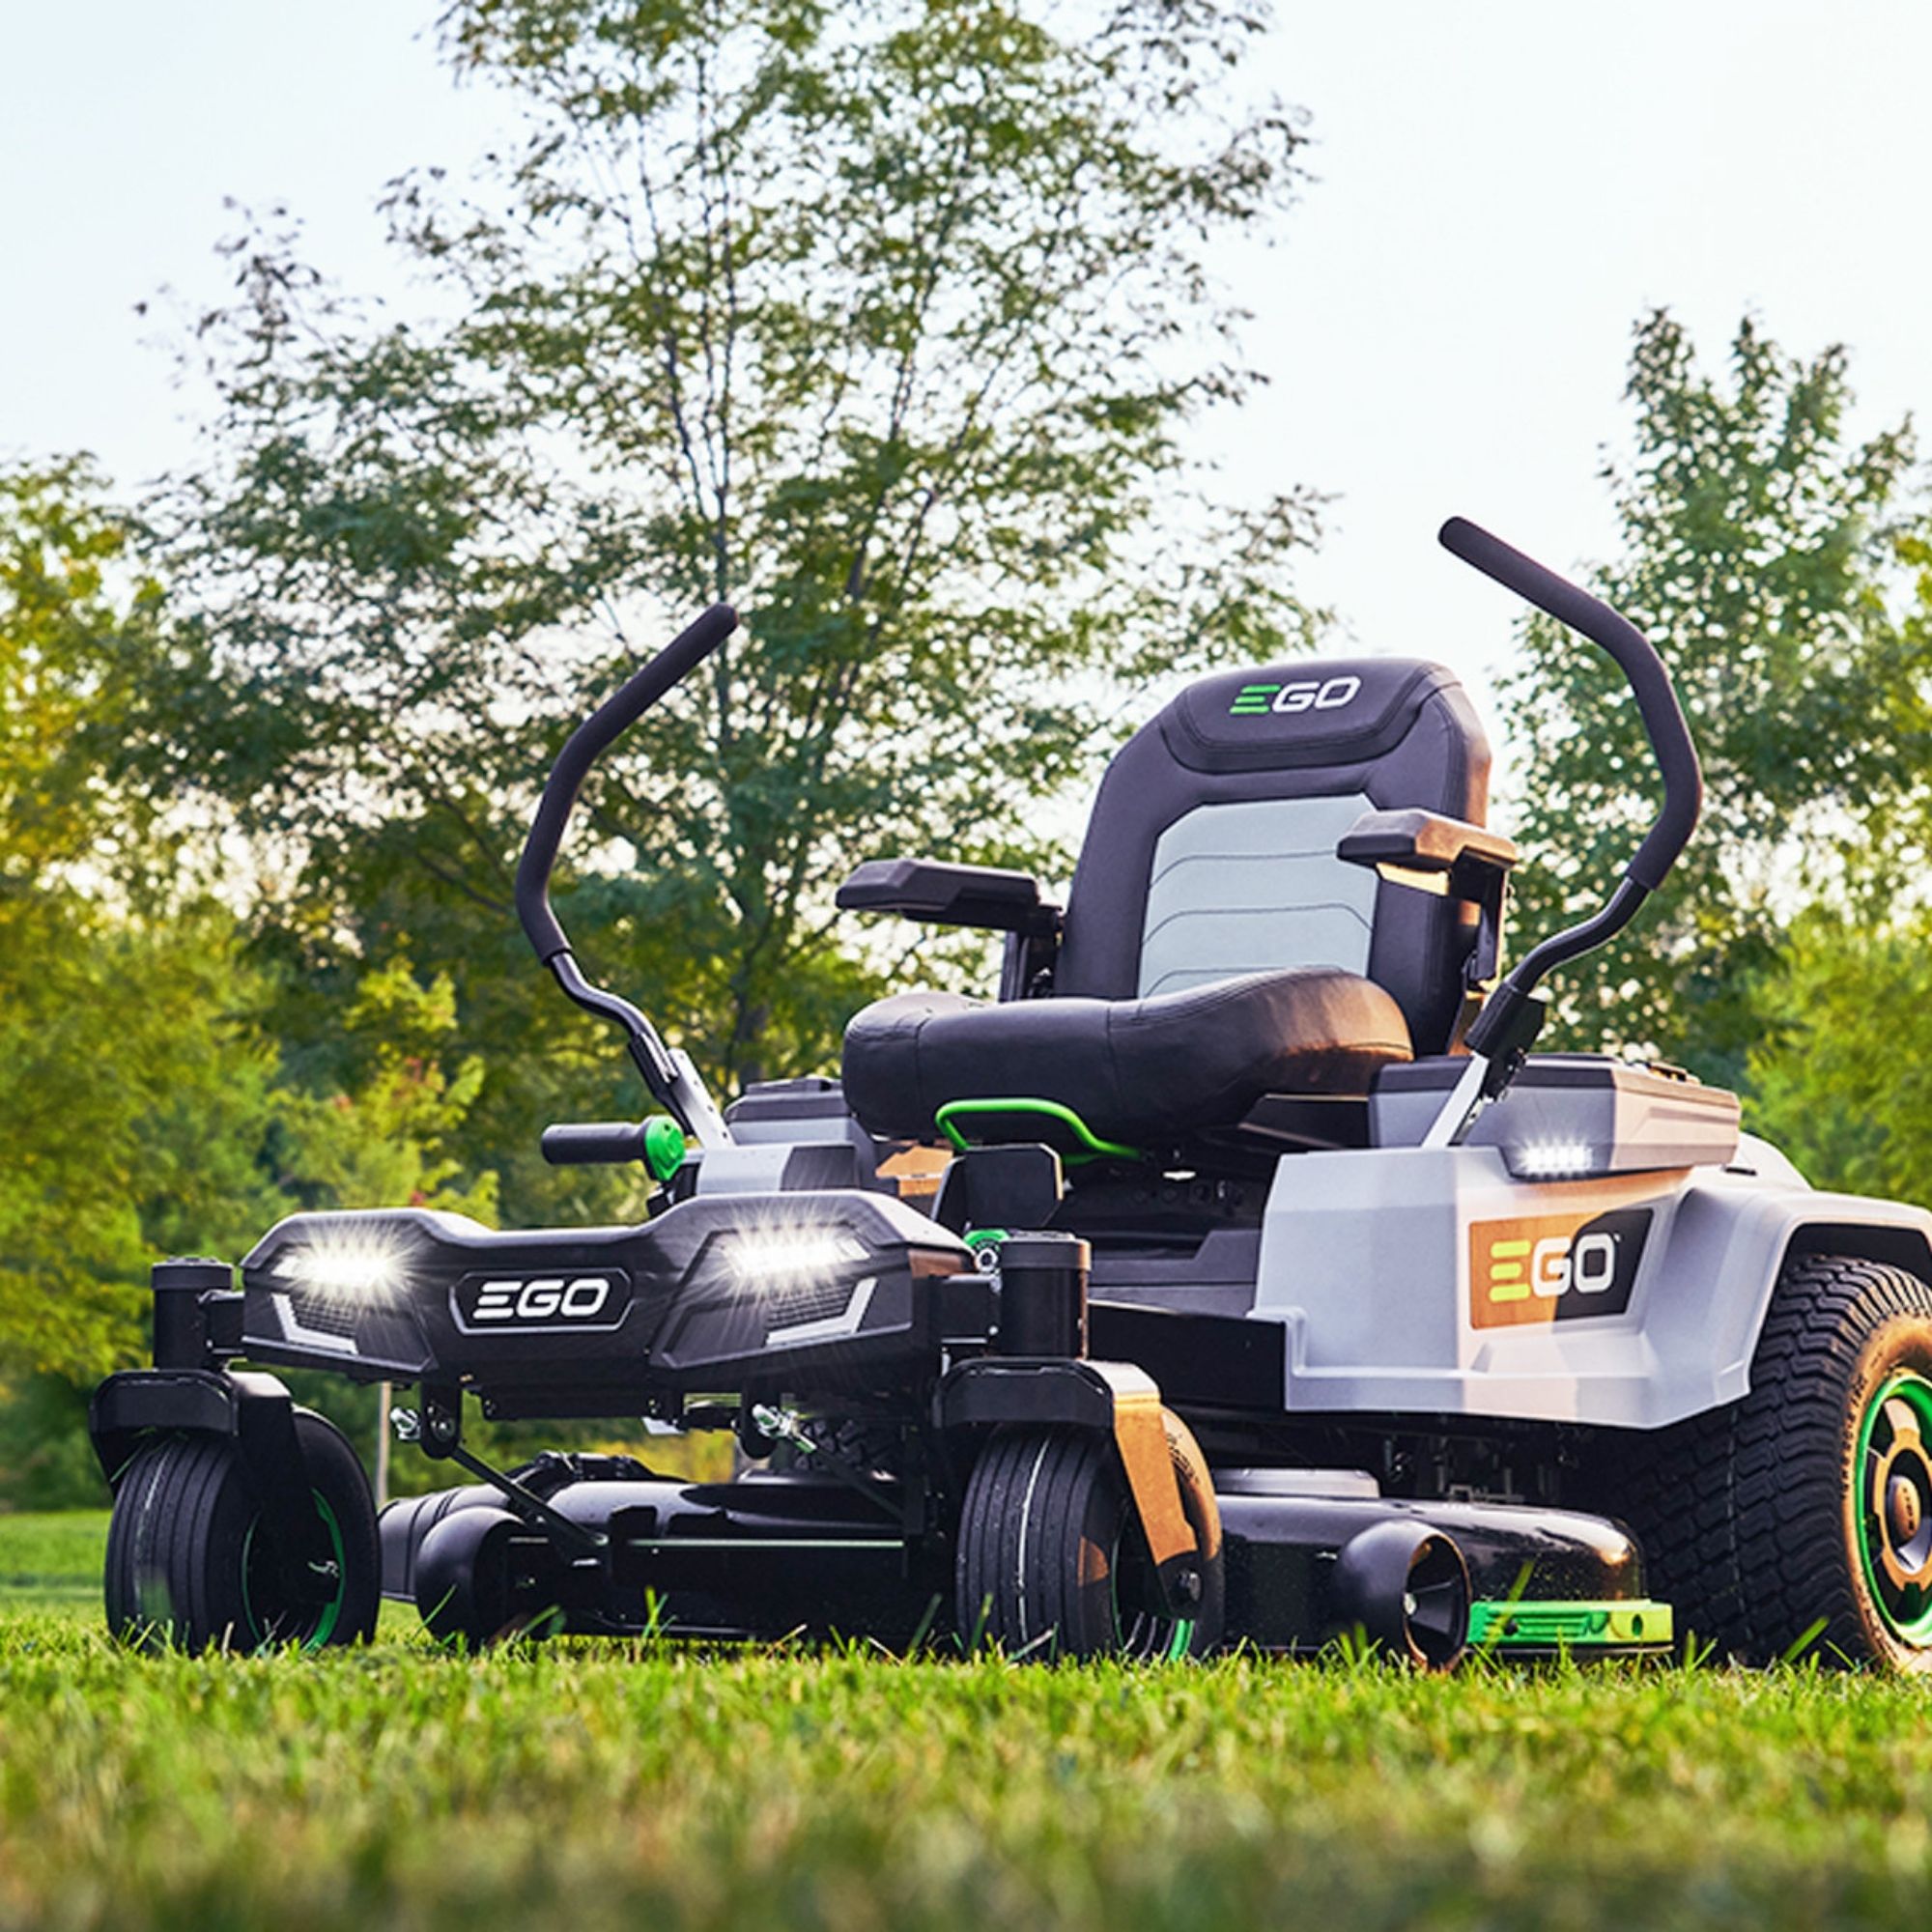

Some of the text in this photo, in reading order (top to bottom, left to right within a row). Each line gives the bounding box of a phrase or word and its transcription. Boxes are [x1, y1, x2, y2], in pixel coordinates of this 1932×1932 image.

[1229, 675, 1362, 715] EGO
[1489, 1232, 1617, 1304] EGO
[471, 1277, 611, 1321] EGO
